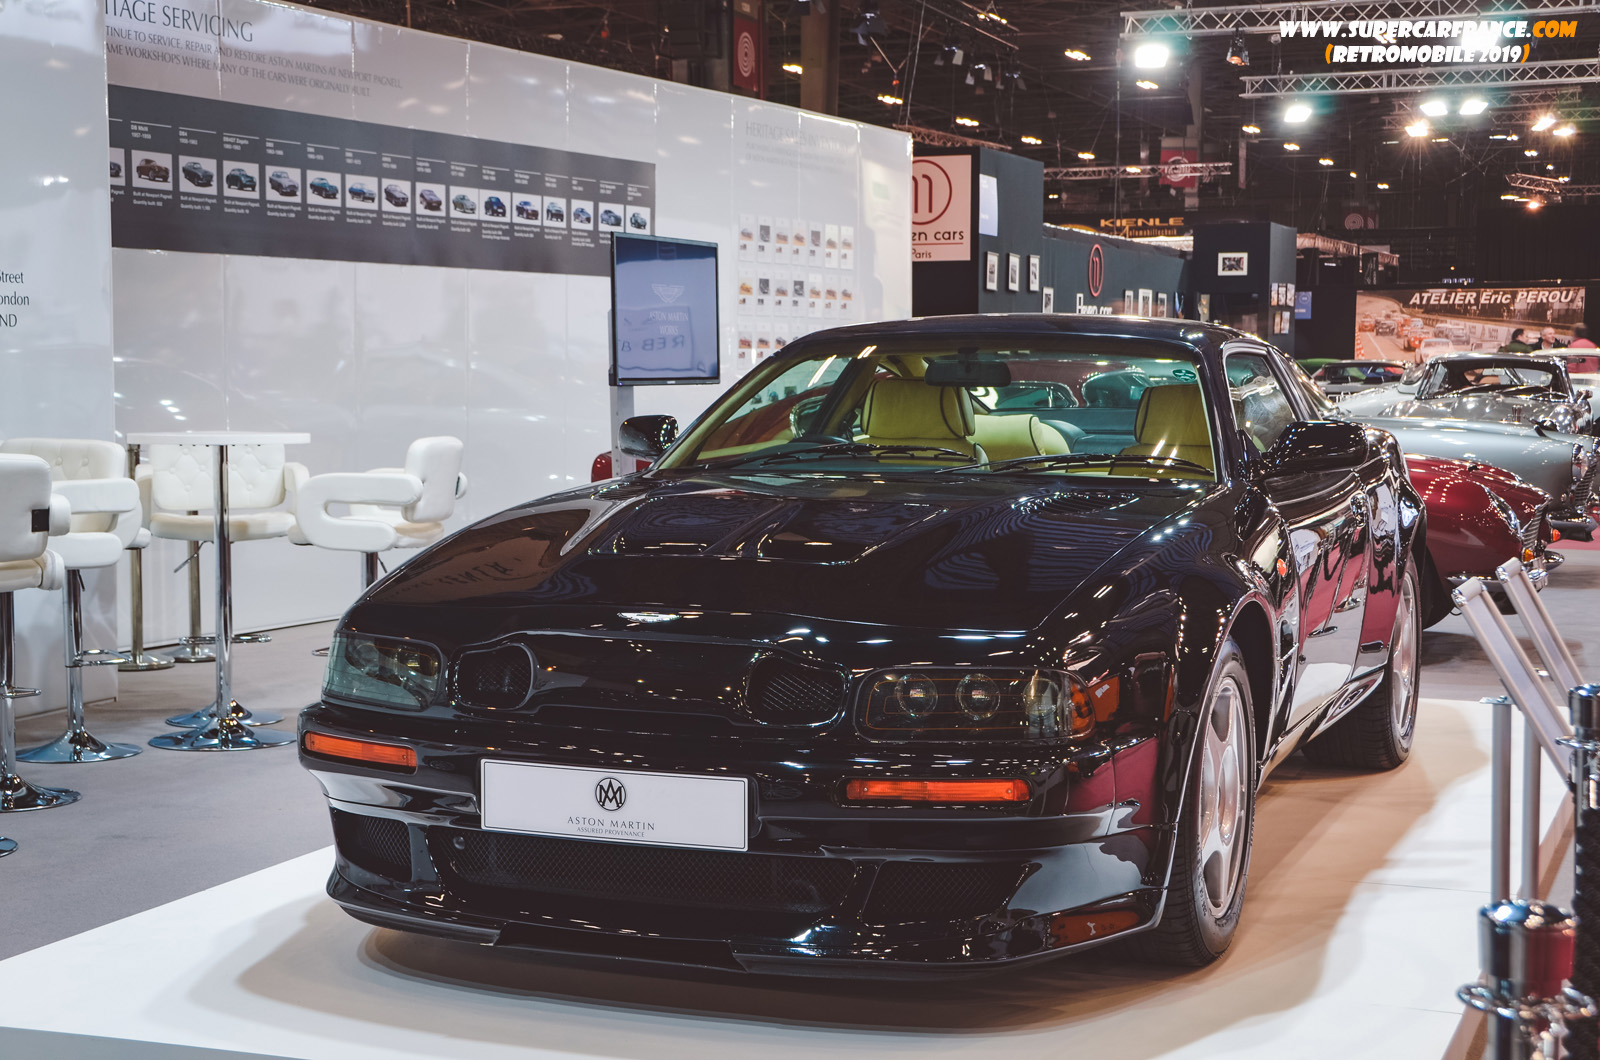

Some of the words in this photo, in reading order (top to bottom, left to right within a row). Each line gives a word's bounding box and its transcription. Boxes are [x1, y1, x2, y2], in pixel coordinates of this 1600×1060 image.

[162, 5, 253, 42] SERVICING
[106, 25, 132, 41] TINUE
[134, 30, 146, 42] TO
[148, 33, 183, 49] SERVICE,
[185, 40, 212, 54] REPAIR
[215, 46, 232, 57] AND
[234, 50, 266, 64] RESTORE
[268, 56, 294, 68] ASTON
[295, 61, 327, 76] MARTINS
[124, 46, 181, 65] WORKSHOPS
[182, 58, 210, 70] WHERE
[239, 66, 250, 77] OF
[252, 68, 266, 79] THE
[268, 71, 287, 83] CARS
[288, 75, 307, 87] WERE
[1100, 217, 1184, 228] KIENLE
[934, 230, 964, 241] cars
[0, 270, 24, 284] treet
[1409, 292, 1477, 305] ATELIER
[1480, 292, 1512, 305] Eric
[1516, 290, 1574, 303] PEROU
[567, 816, 605, 827] ASTON
[610, 819, 656, 831] MARTIN
[577, 827, 604, 835] ASSURED
[605, 828, 645, 838] PROVENANCE
